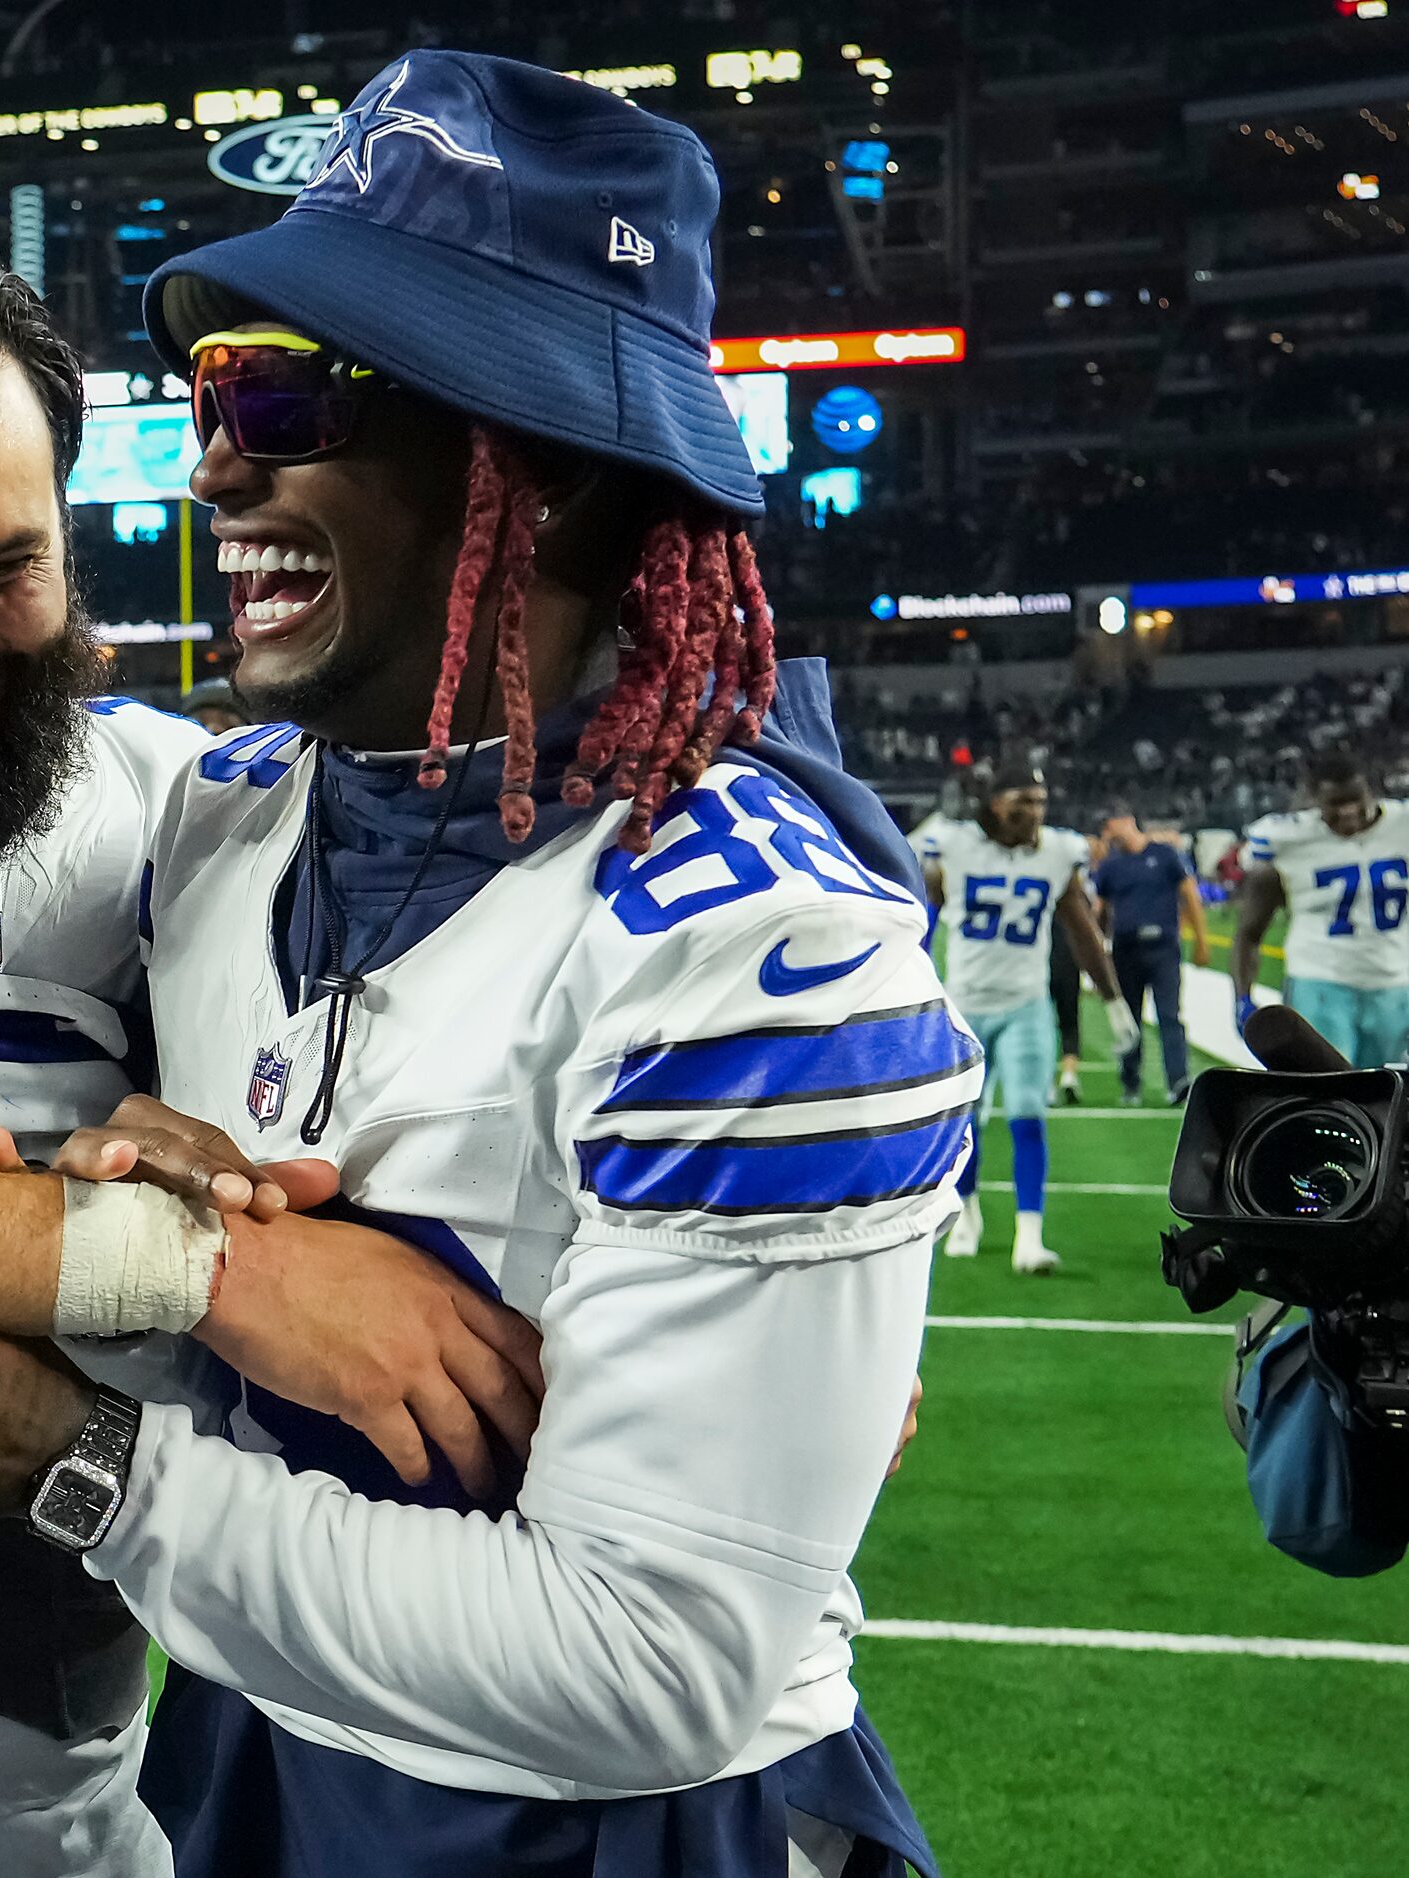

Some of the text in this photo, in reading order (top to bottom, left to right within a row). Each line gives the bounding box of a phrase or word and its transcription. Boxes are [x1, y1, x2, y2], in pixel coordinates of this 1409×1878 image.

[962, 875, 1050, 944] 53
[1315, 859, 1409, 936] 76
[251, 1079, 275, 1115] NFL
